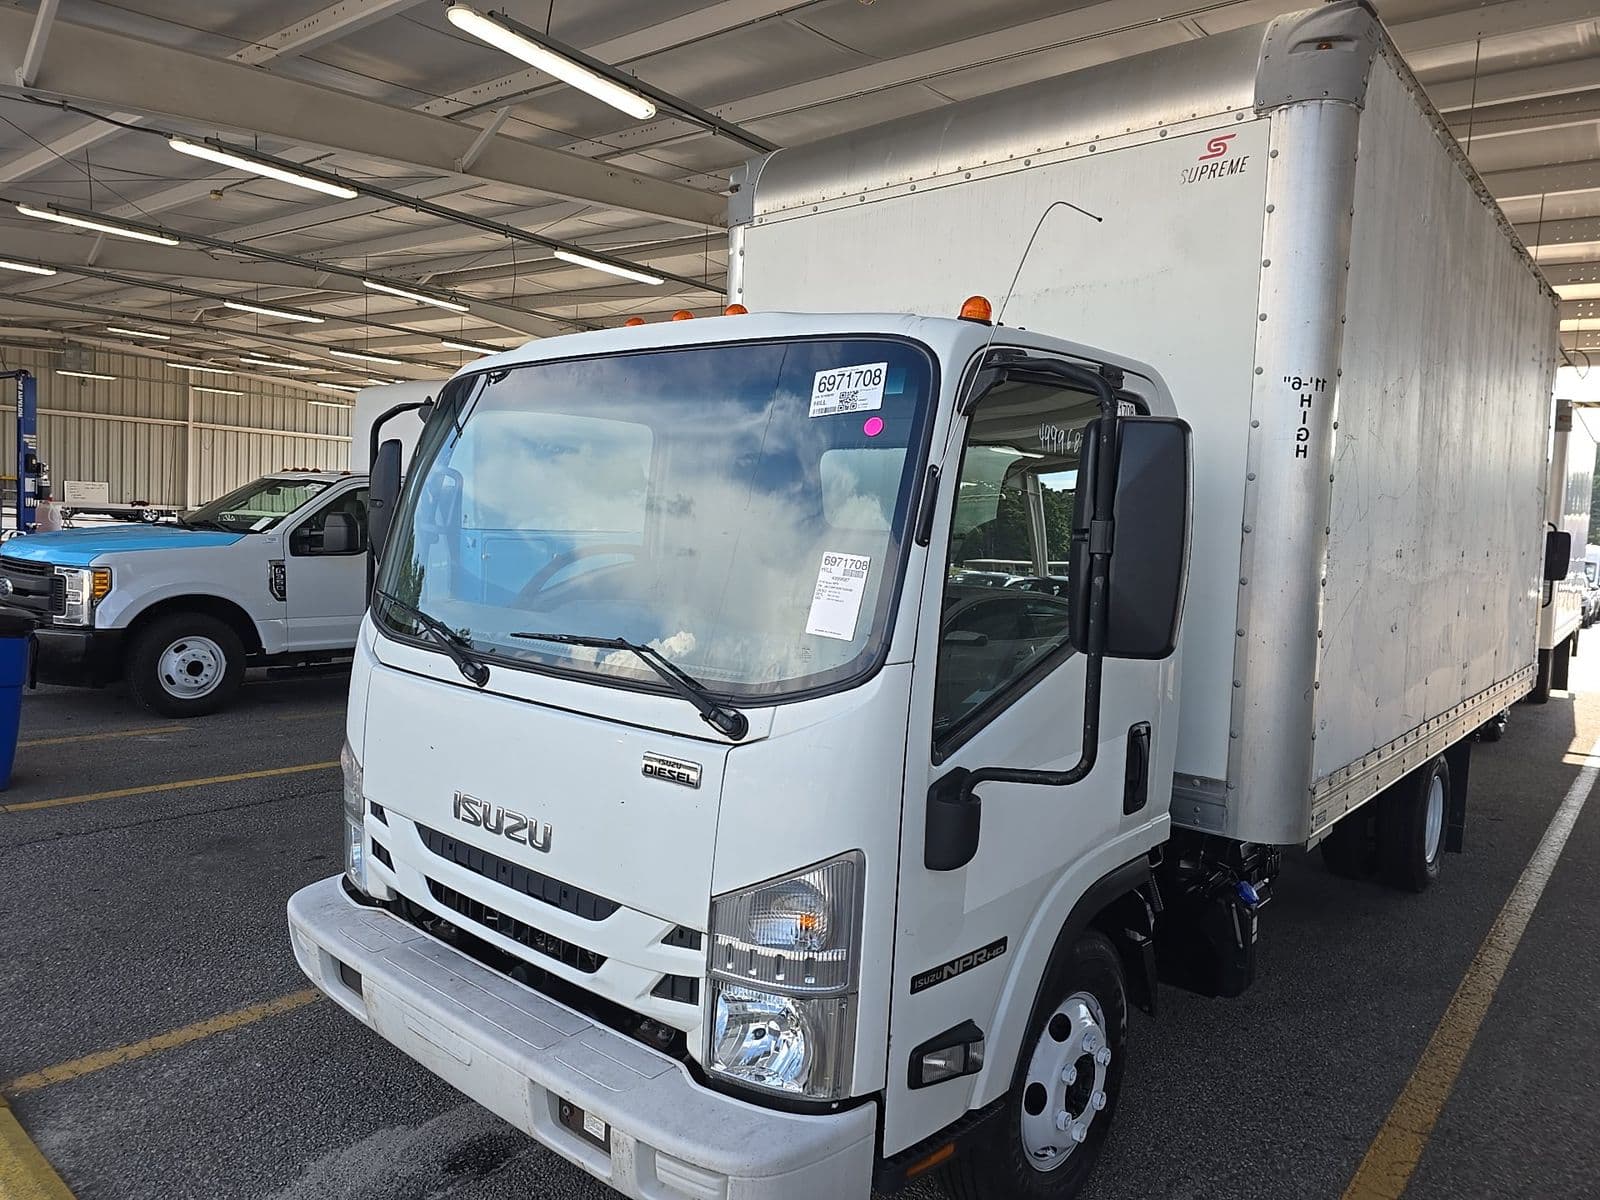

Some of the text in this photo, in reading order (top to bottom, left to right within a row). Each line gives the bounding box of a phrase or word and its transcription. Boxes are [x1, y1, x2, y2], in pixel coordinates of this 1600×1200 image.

[1180, 155, 1250, 185] SUPREME
[818, 368, 882, 393] 6971708
[824, 556, 868, 571] 6971708
[643, 763, 696, 786] DIESEL
[658, 758, 682, 770] ISUZU
[453, 790, 553, 853] ISUZU
[914, 971, 943, 989] ISUZU
[942, 948, 987, 980] NPR
